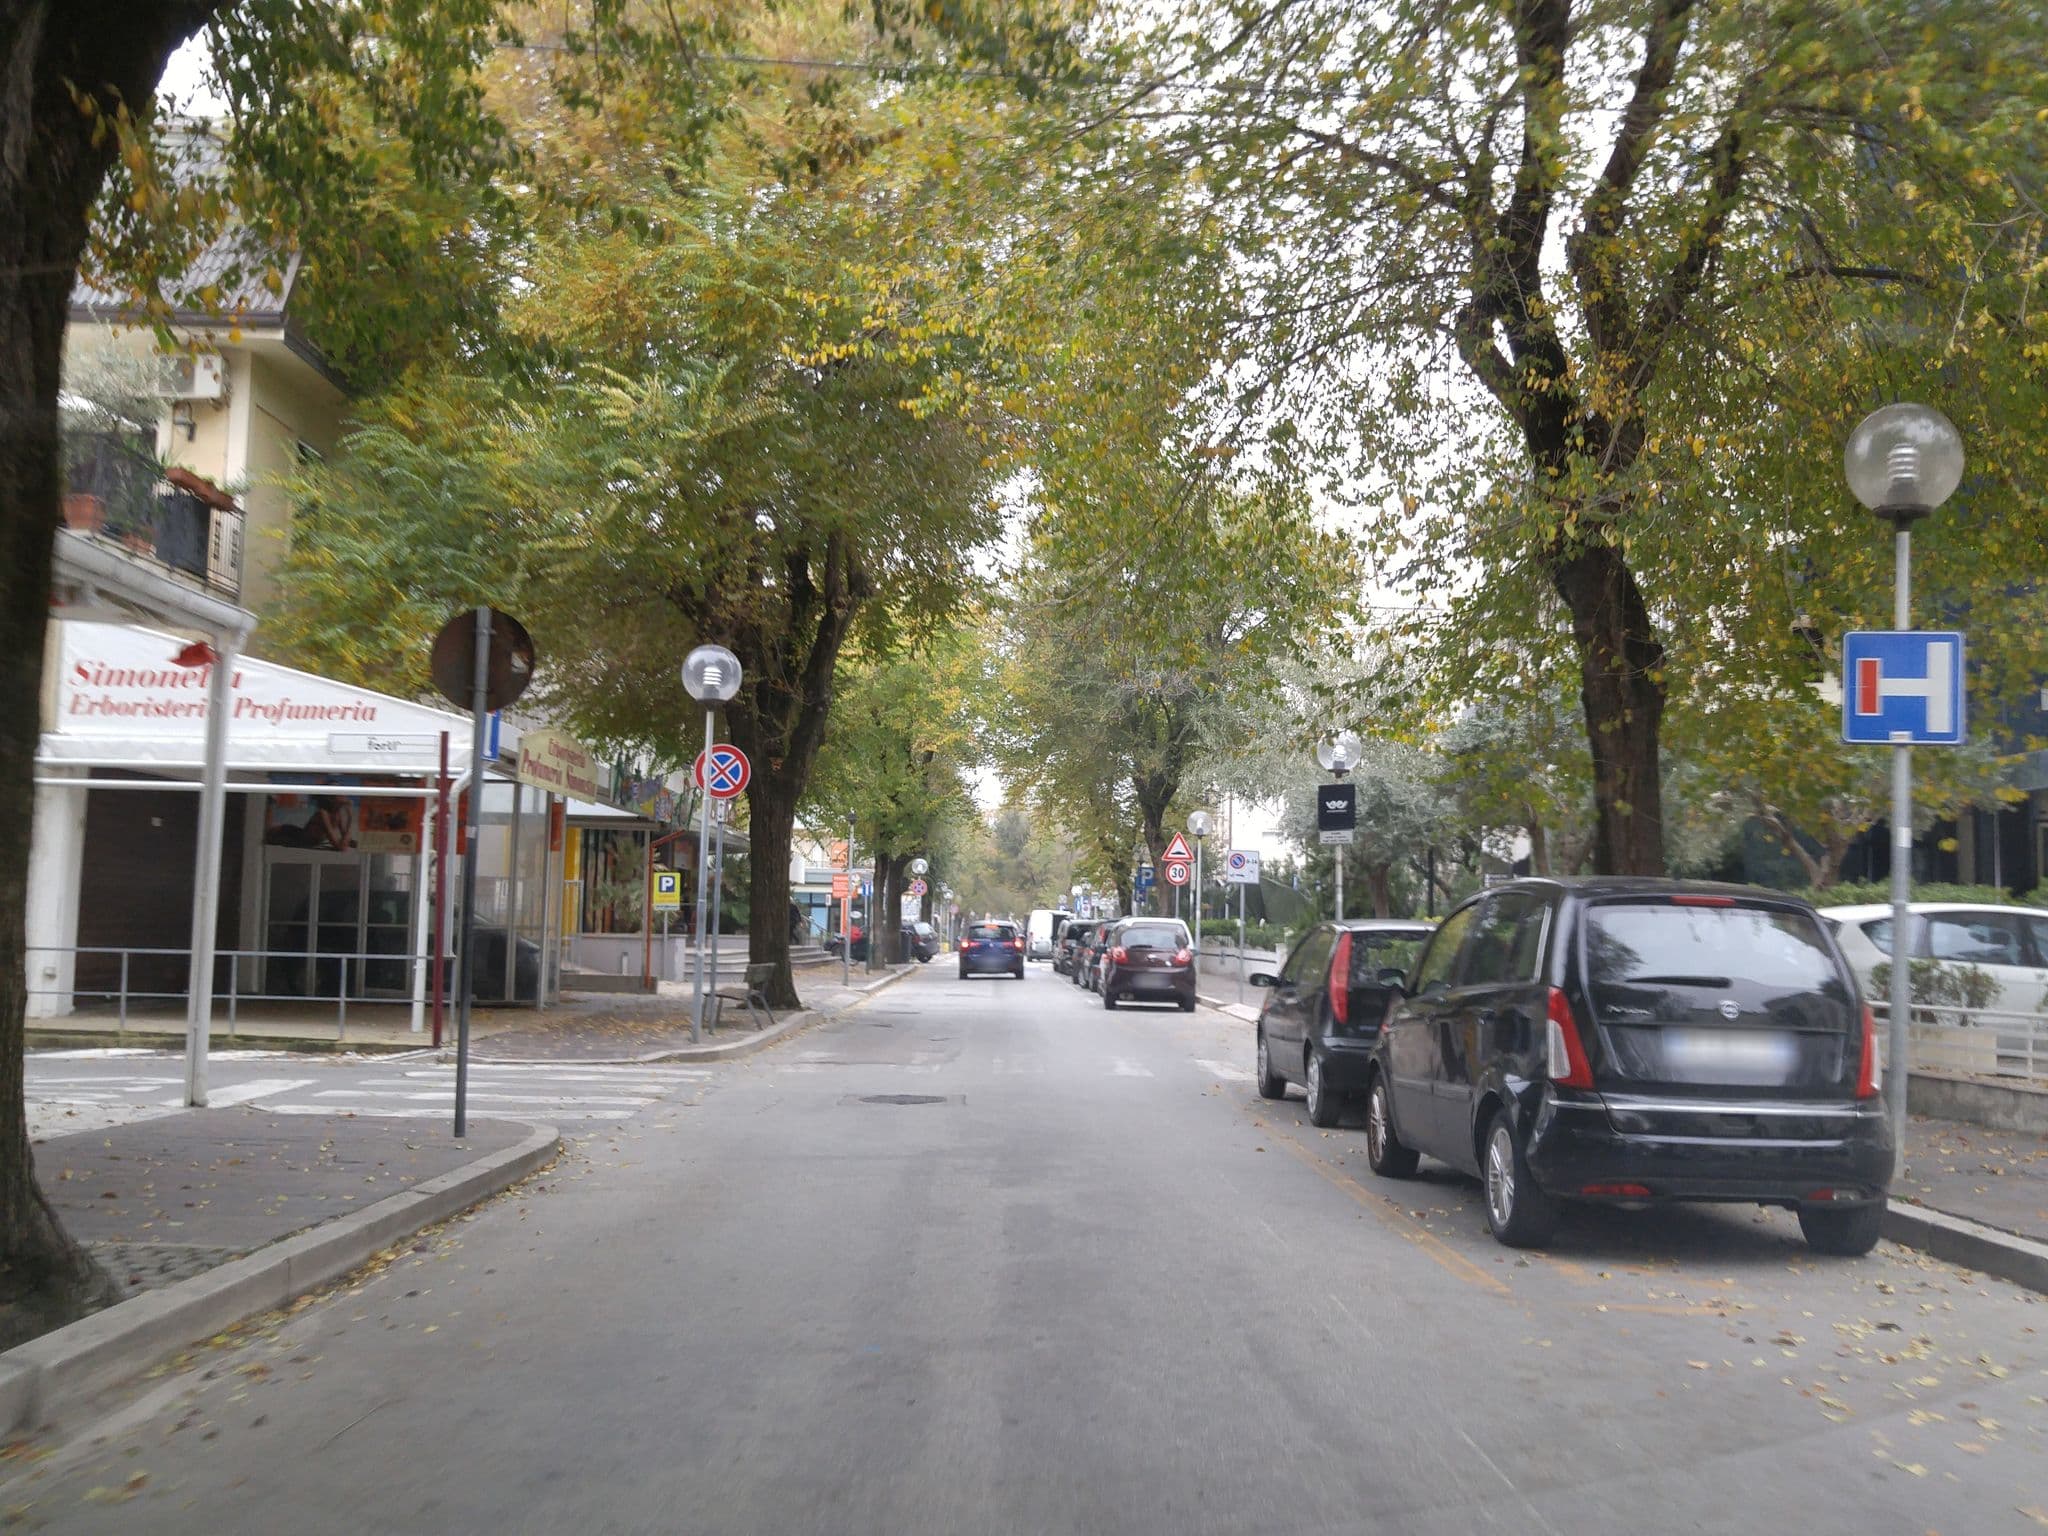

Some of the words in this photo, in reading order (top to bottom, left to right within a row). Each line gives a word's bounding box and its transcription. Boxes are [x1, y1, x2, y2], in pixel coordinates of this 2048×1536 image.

[68, 659, 242, 689] Simoneta
[69, 693, 210, 718] Erboristeri
[232, 696, 378, 727] Profumeria
[1141, 868, 1154, 885] P
[1171, 867, 1185, 879] 30
[660, 876, 674, 891] P
